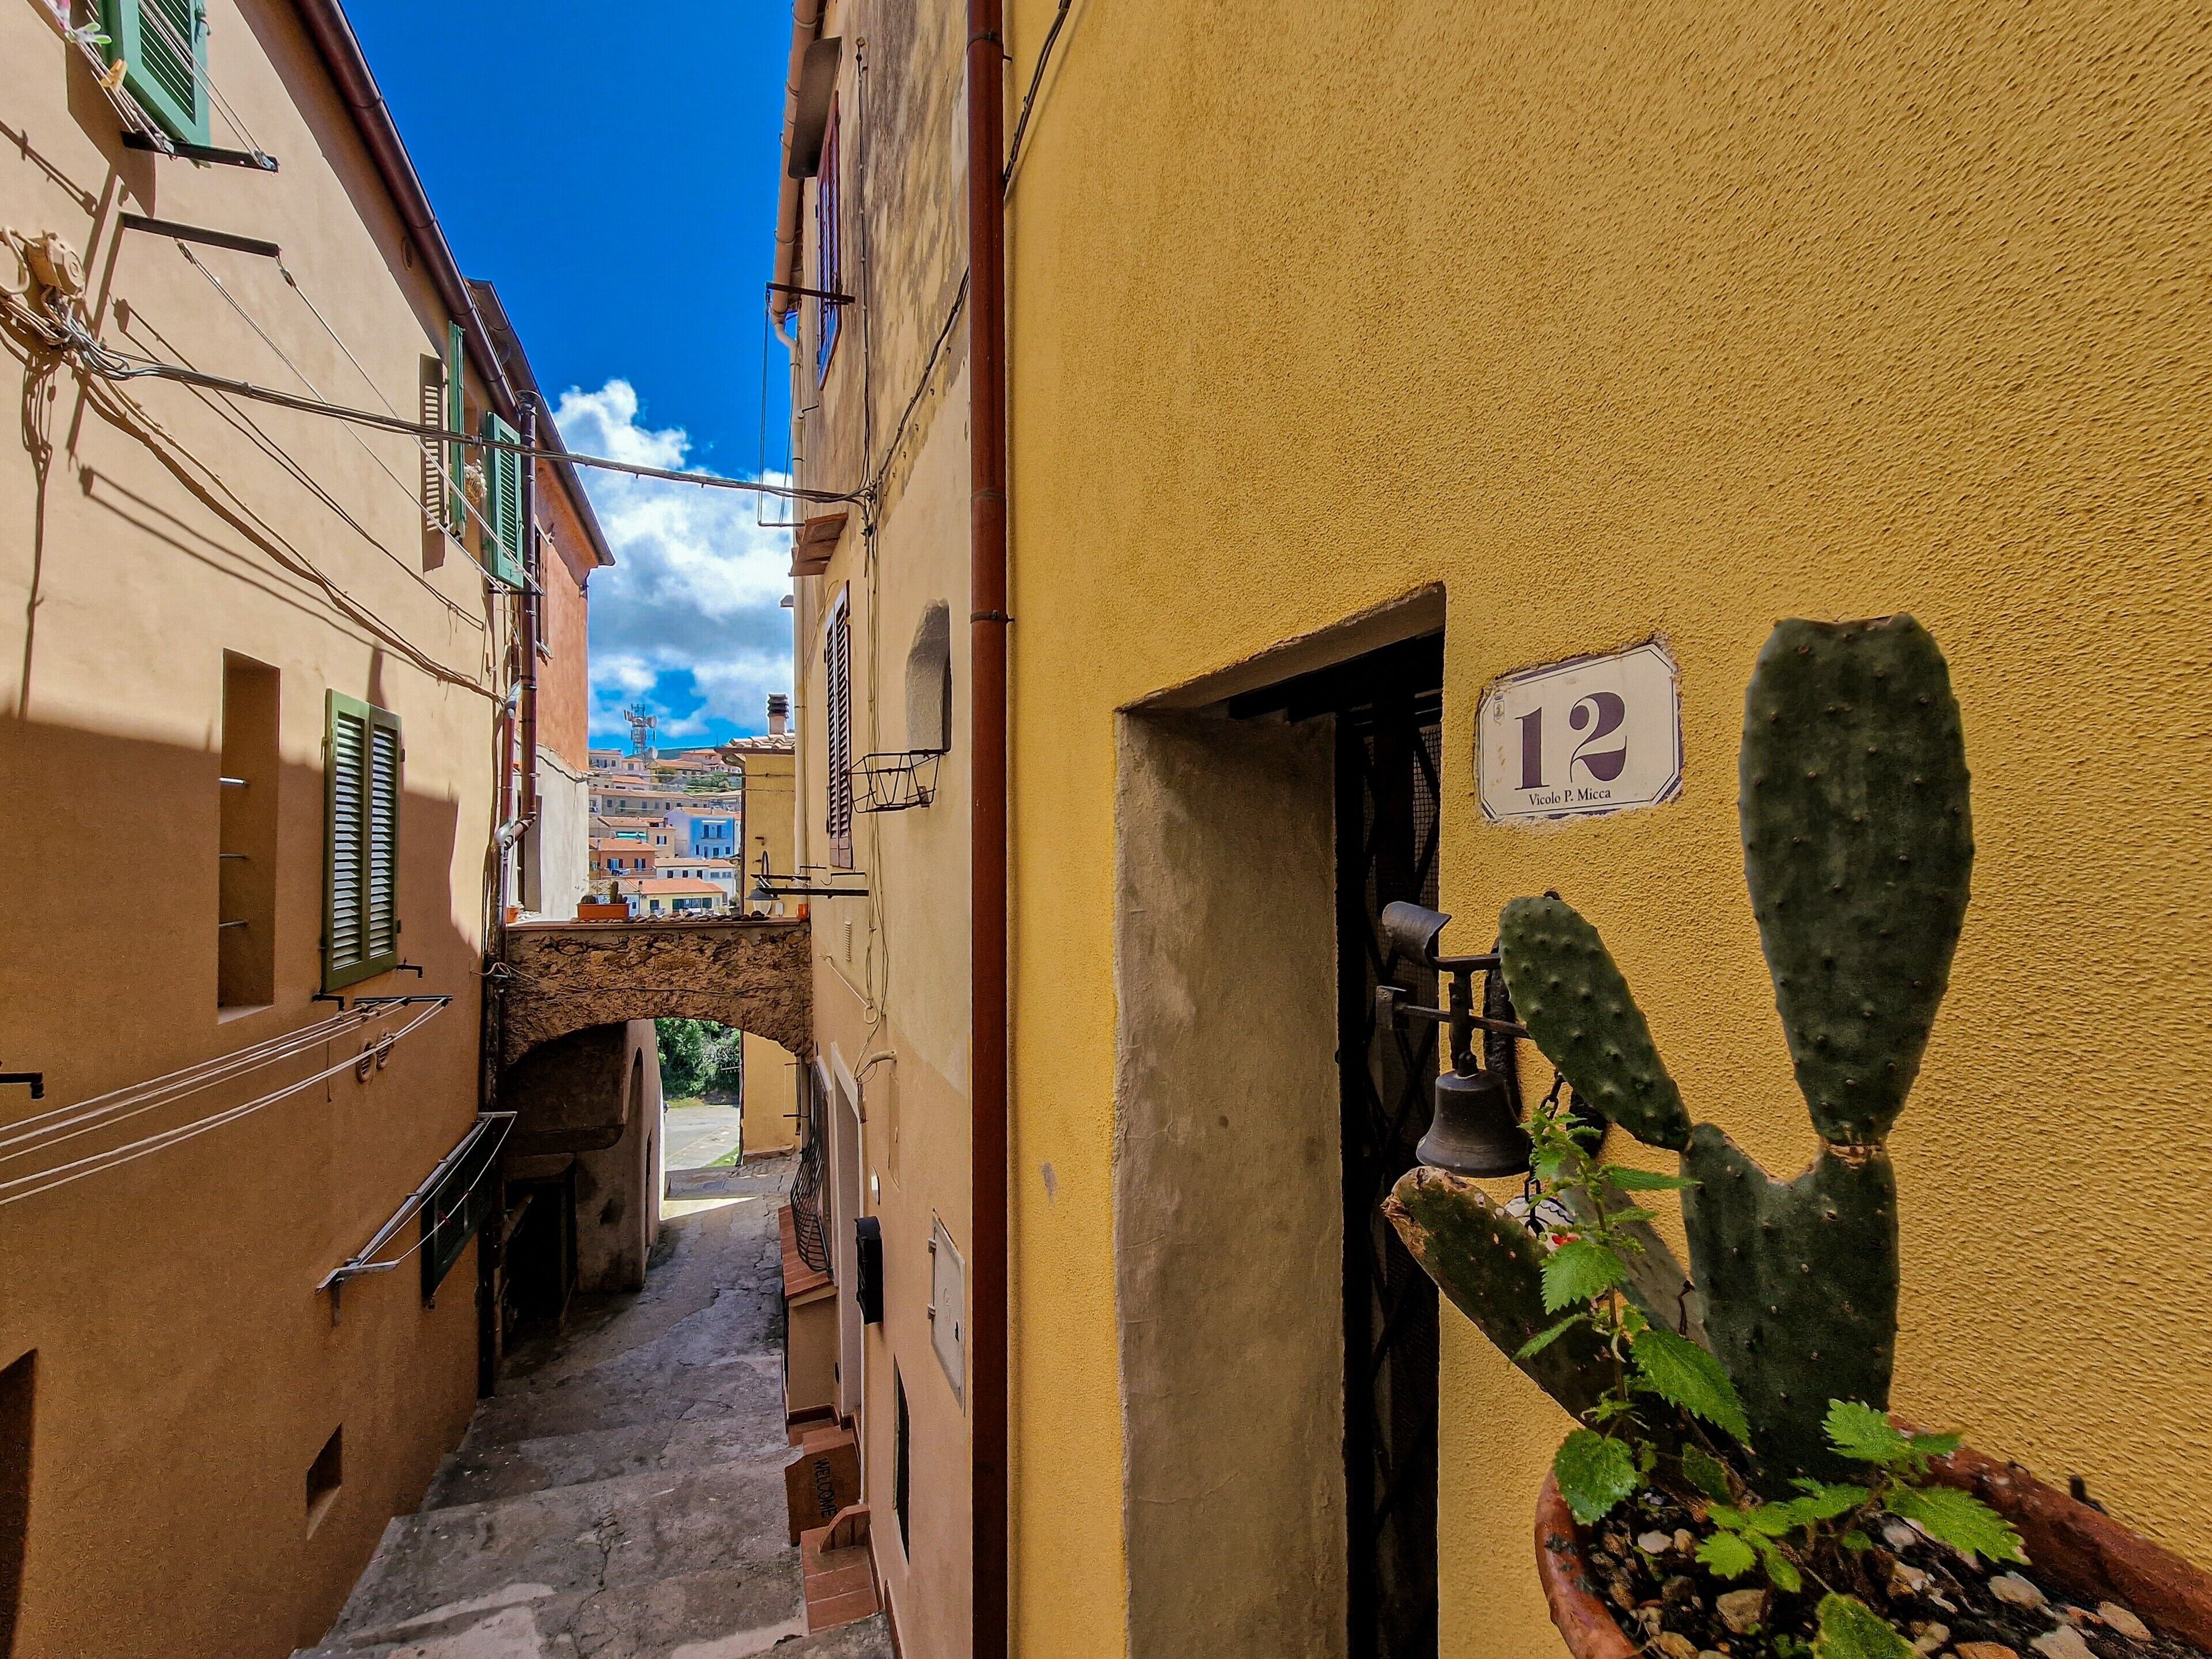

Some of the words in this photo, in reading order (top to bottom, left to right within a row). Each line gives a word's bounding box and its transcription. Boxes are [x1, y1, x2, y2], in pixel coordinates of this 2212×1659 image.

[1514, 691, 1627, 791] 12
[1528, 791, 1561, 806] Vicolo
[1564, 789, 1574, 802] P.
[1577, 787, 1611, 801] Micca
[813, 1456, 838, 1518] WELCOME
